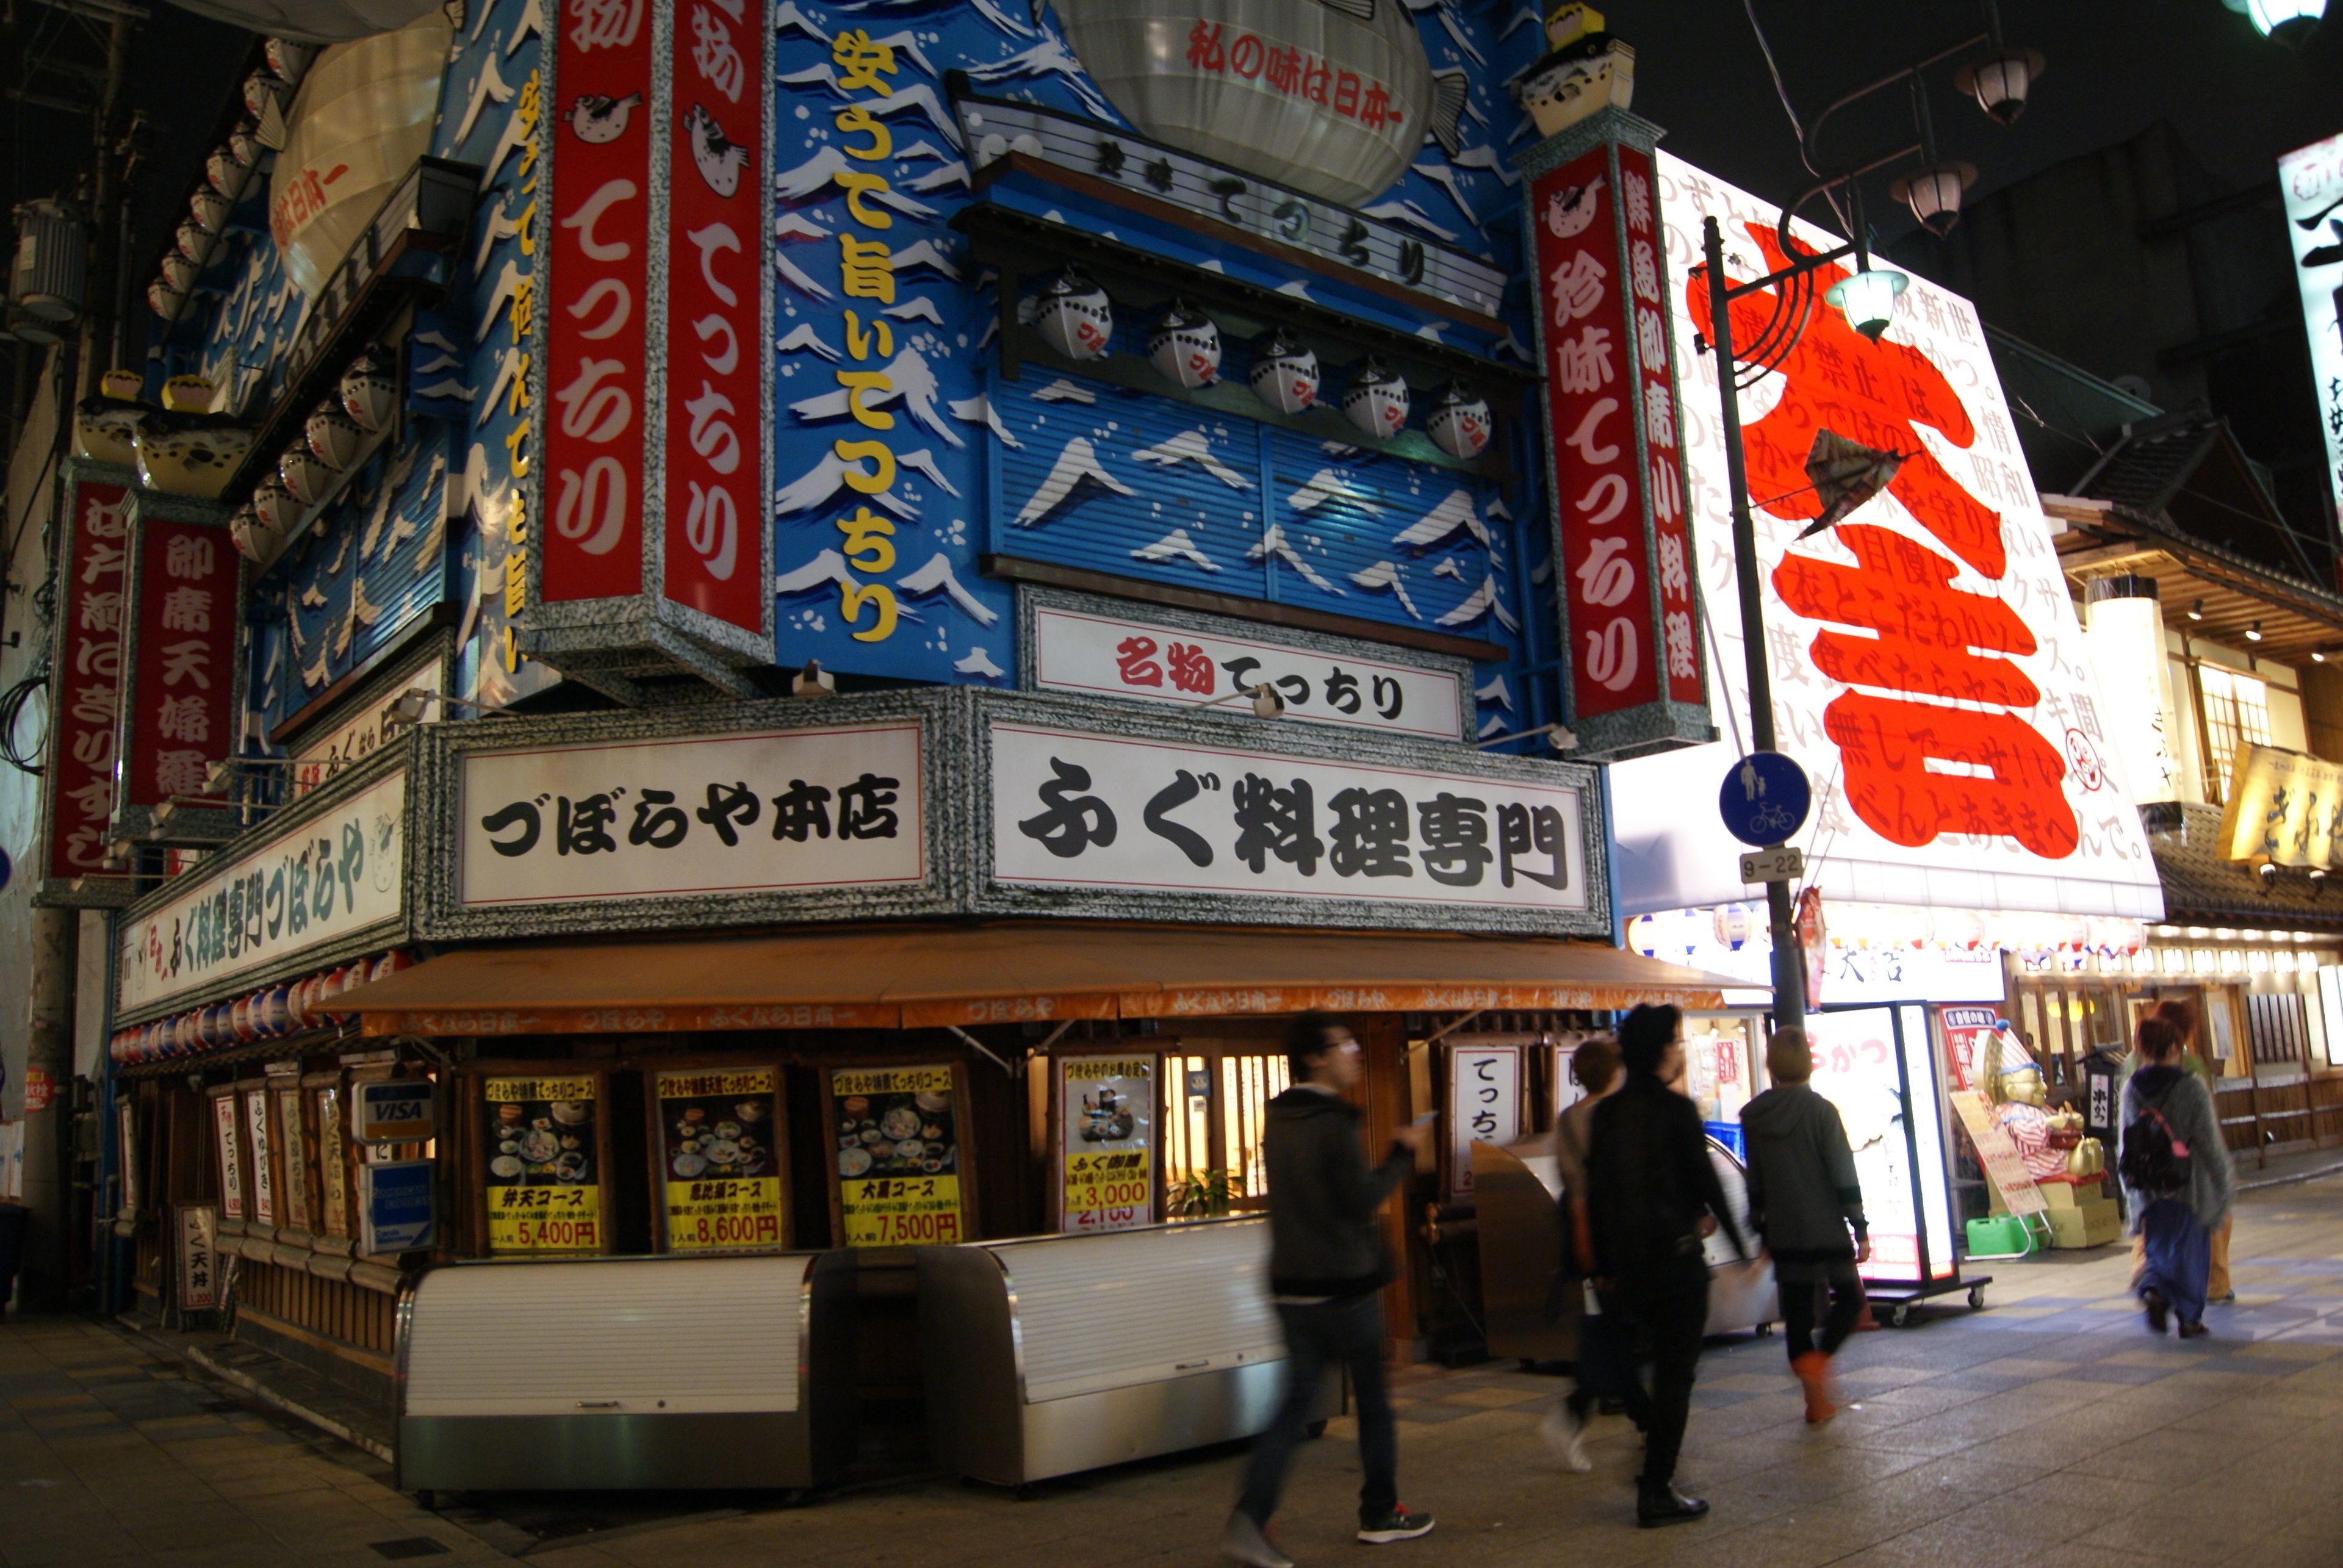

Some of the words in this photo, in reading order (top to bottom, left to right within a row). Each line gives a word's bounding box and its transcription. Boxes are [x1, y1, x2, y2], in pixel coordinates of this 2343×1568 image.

[1186, 18, 1405, 131] 私の味は日本一
[556, 178, 637, 556] てっちり
[685, 222, 741, 581] てっちり
[1550, 250, 1638, 692] 珍味てっちり
[156, 534, 215, 797] 即席天婦羅
[481, 773, 901, 857] づぼらや本店
[1018, 756, 1569, 891] ふぐ料理専門
[1743, 854, 1799, 877] 9-22
[374, 1100, 422, 1121] VISA
[1472, 1059, 1497, 1143] てっち
[502, 1188, 583, 1207] 弁天コース
[518, 1221, 596, 1246] 5,400円
[697, 1215, 778, 1245] 8,600円
[877, 1213, 958, 1245] 7,500円
[1085, 1182, 1145, 1207] 3,000
